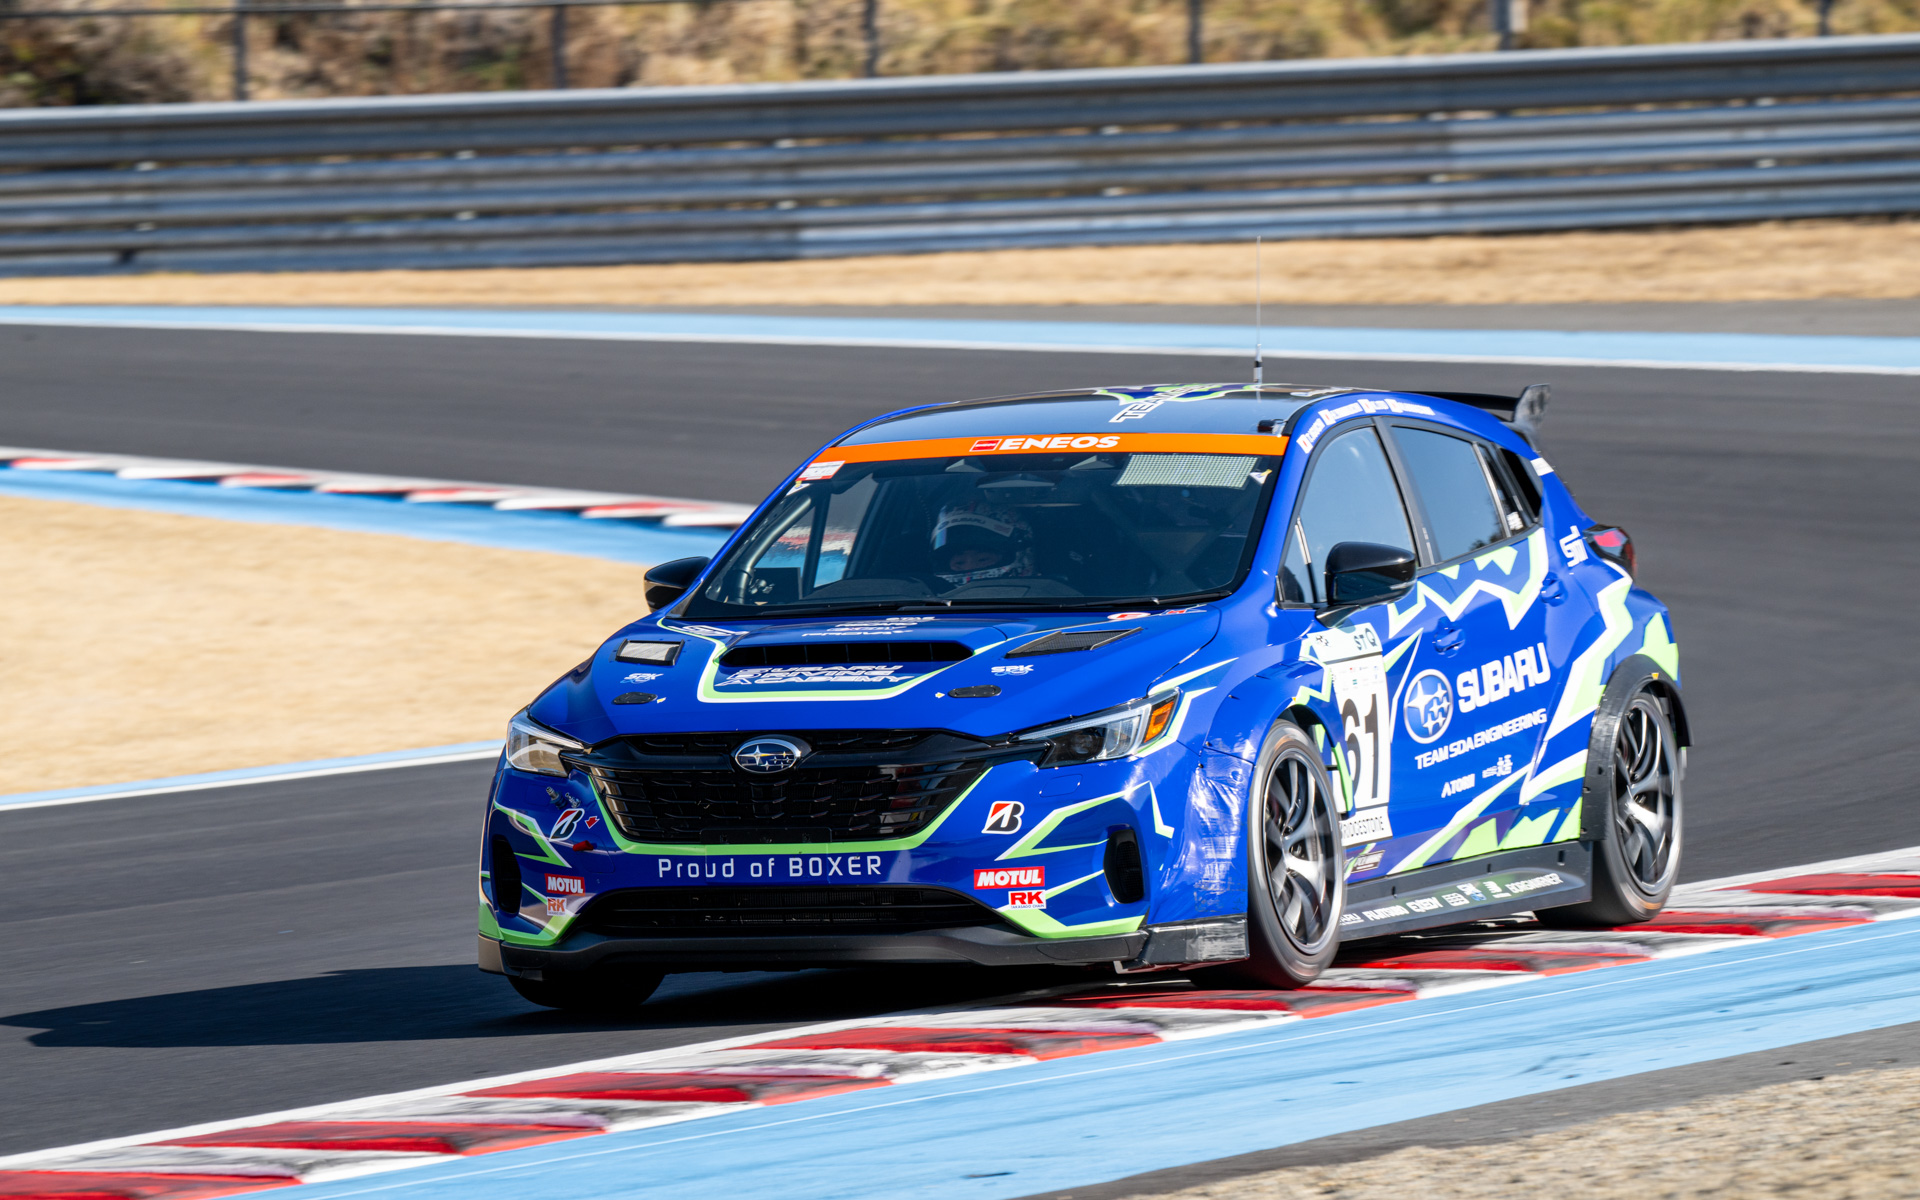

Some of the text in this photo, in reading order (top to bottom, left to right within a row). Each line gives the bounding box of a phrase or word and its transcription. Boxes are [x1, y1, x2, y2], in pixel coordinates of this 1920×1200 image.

[999, 436, 1120, 450] ENEOS
[1456, 642, 1551, 713] SUBARU
[1341, 692, 1379, 800] 61
[1414, 708, 1547, 769] TEAM SDA ENGINEERING
[658, 855, 882, 878] Proud of BOXER
[547, 875, 584, 894] MOTUL
[976, 869, 1042, 887] MOTUL
[547, 897, 565, 912] RK
[1010, 891, 1044, 905] RK
